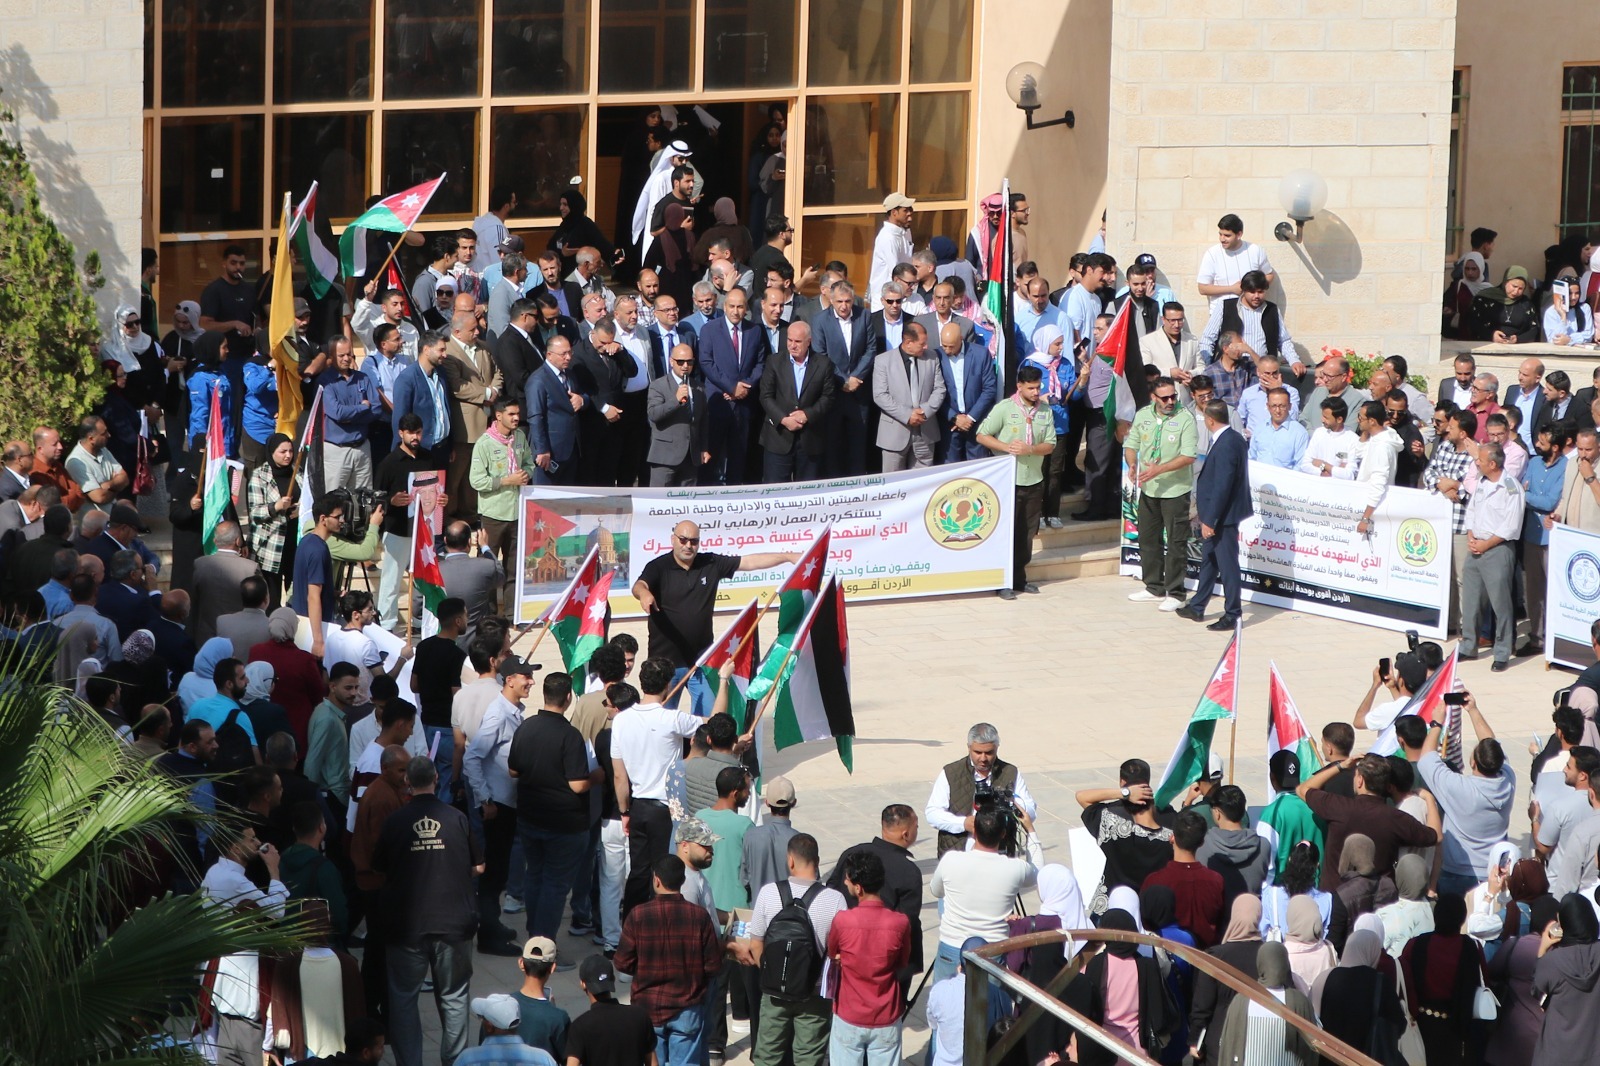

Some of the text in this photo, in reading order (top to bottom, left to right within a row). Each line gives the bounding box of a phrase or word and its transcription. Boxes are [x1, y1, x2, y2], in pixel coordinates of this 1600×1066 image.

[649, 489, 907, 517] وأعضاء الهيئتين التدريسية والإدارية وطلبة الجامعة
[781, 513, 817, 526] العمل
[820, 509, 882, 523] يستنكرون
[724, 516, 777, 531] الإرهابي
[700, 521, 908, 551] الذي استهد كنيسة حمود في
[1300, 528, 1319, 539] العمل
[1319, 532, 1350, 544] يستنكرون
[1245, 534, 1259, 547] في
[1260, 538, 1287, 551] حمود
[1289, 541, 1319, 558] كنيسة
[1321, 549, 1359, 564] استهدف
[1361, 555, 1382, 571] الذي
[889, 562, 930, 574] ويقفون
[1293, 561, 1313, 571] القيادة
[1356, 573, 1379, 584] ويقفون
[844, 578, 912, 594] الأردن أقوى
[1295, 584, 1315, 597] بوحدة
[715, 591, 731, 601] حف
[1331, 593, 1351, 603] الأردن
